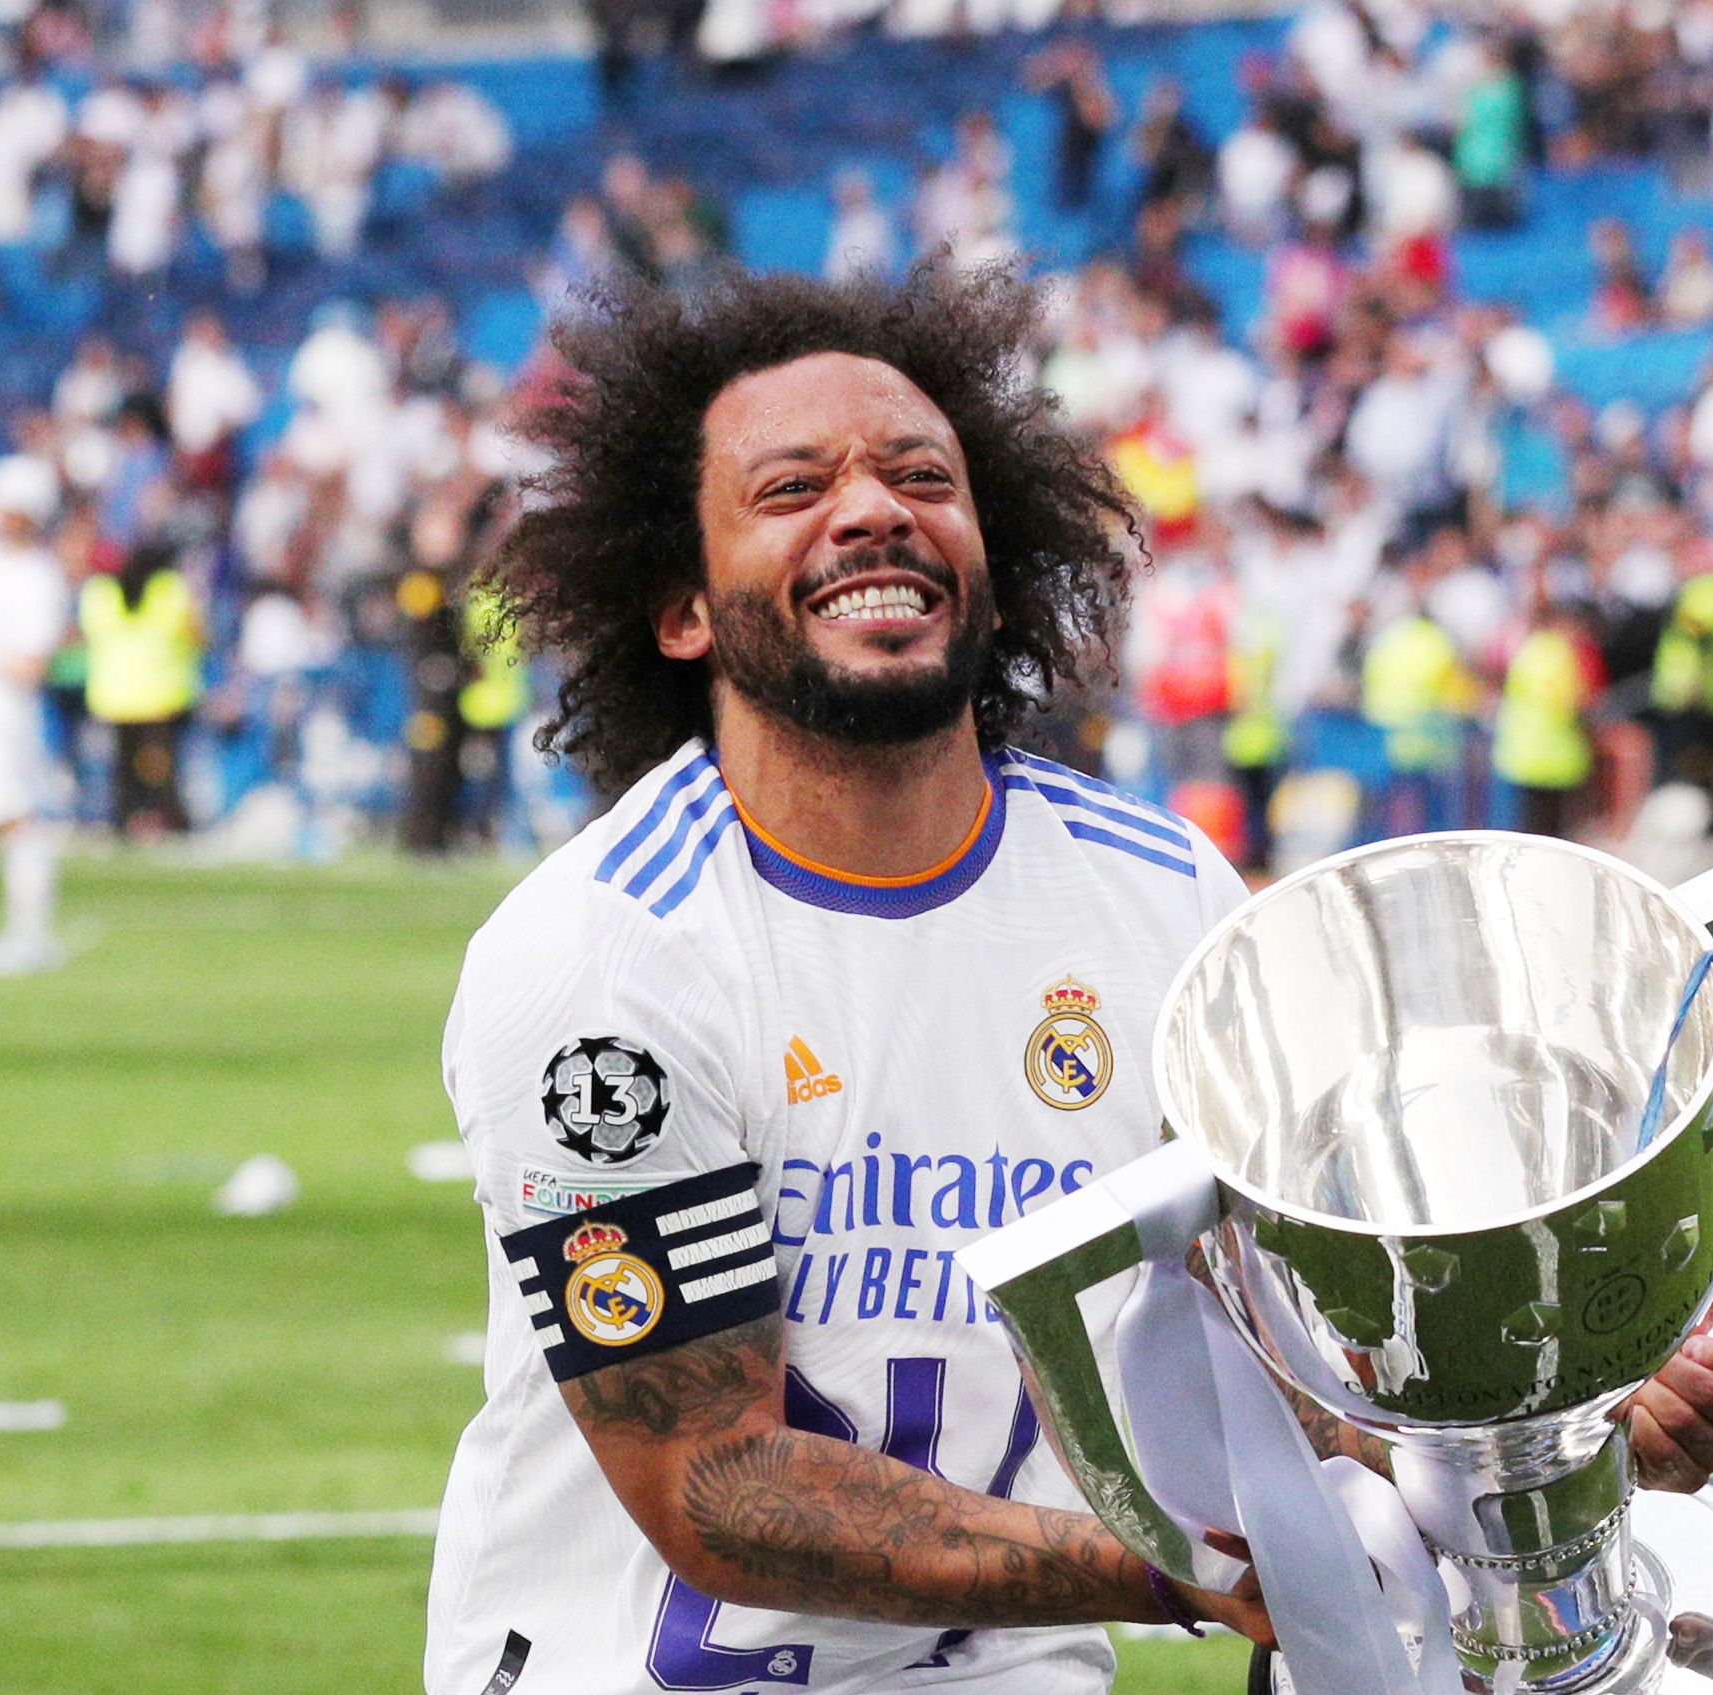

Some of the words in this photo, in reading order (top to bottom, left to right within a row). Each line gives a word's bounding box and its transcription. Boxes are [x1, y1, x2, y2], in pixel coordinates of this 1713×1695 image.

[570, 1073, 639, 1126] 13
[787, 1073, 843, 1105] idas
[523, 1168, 558, 1188] UEFA
